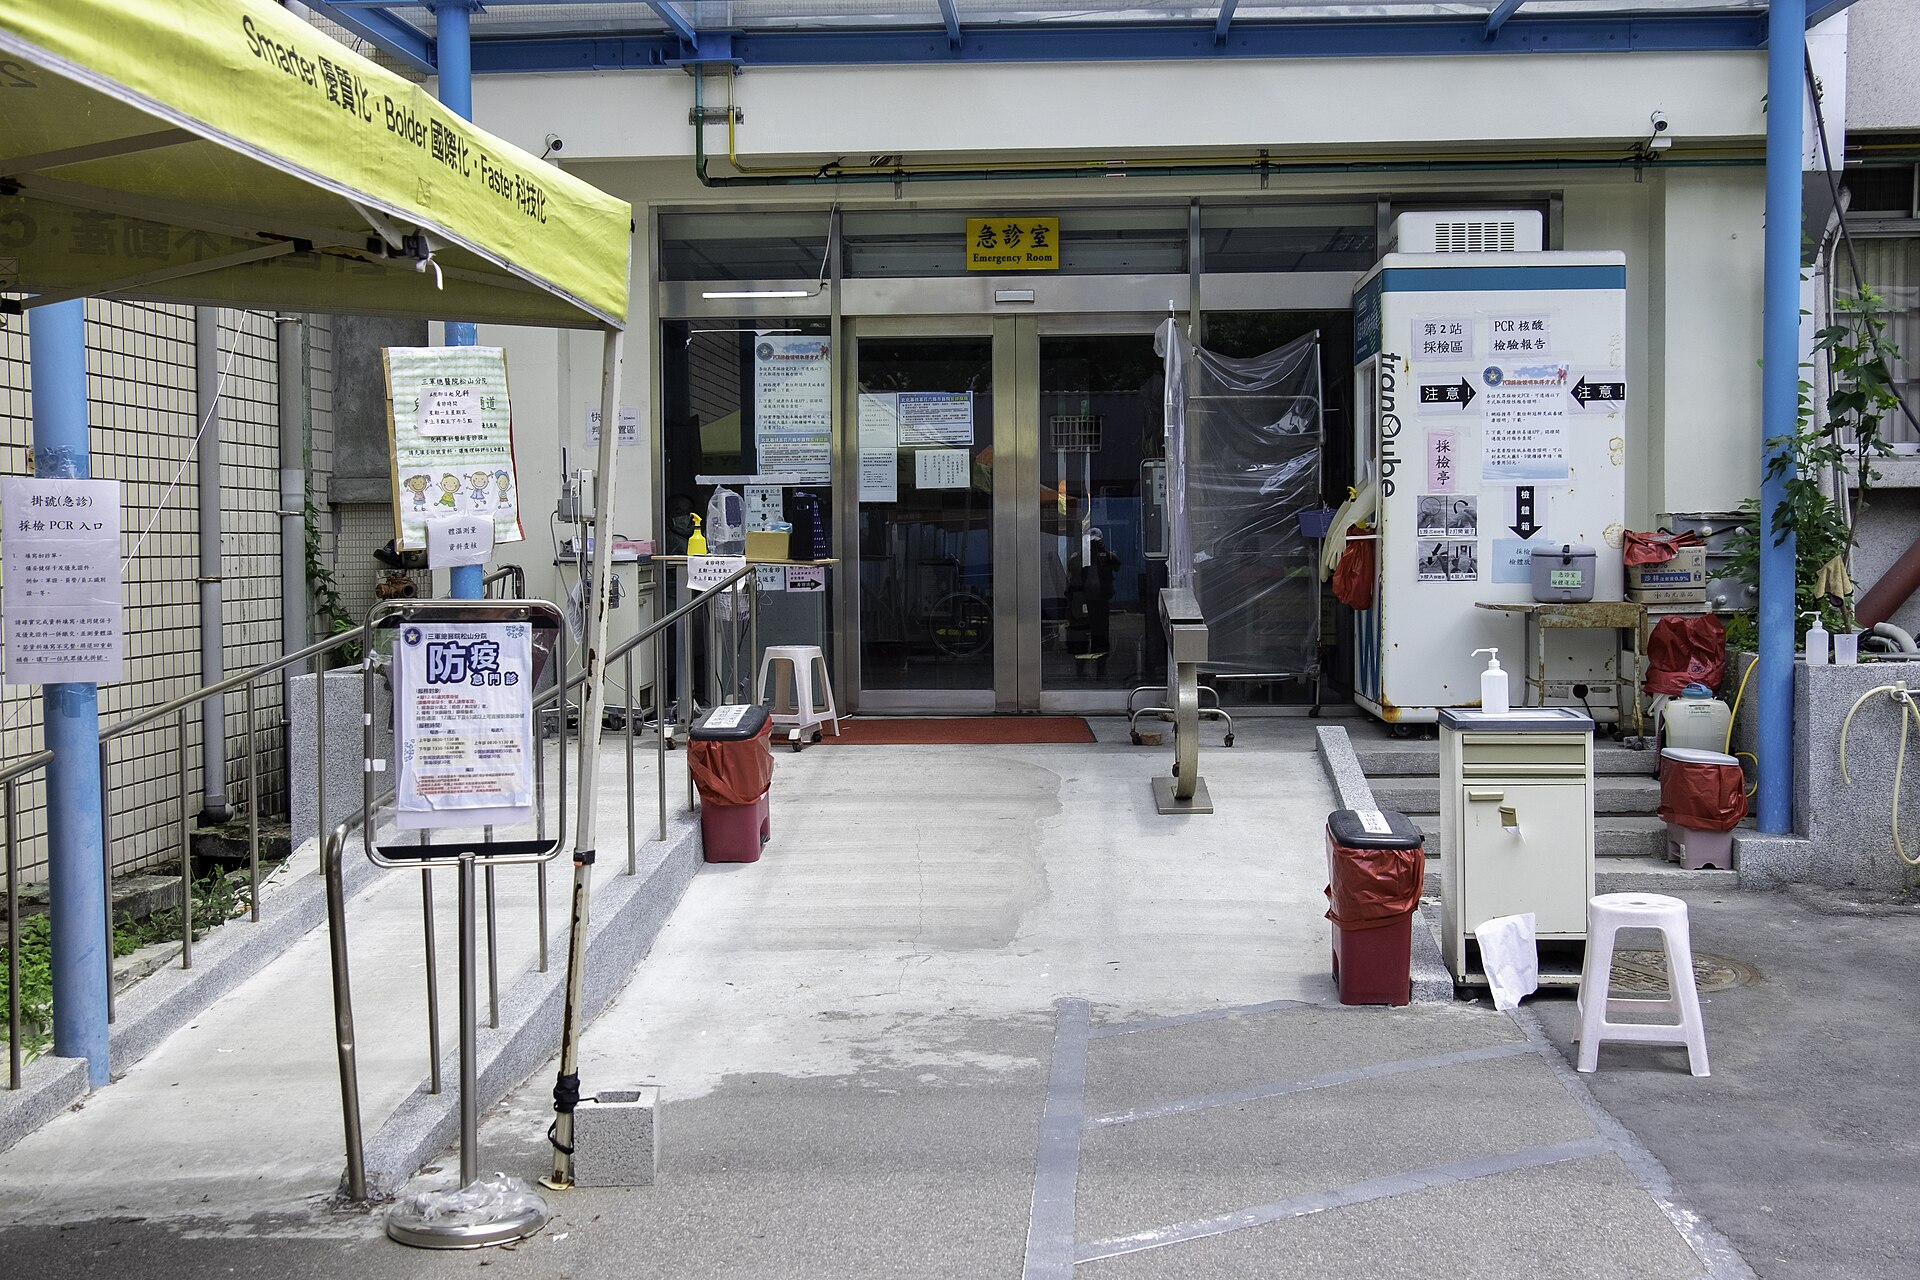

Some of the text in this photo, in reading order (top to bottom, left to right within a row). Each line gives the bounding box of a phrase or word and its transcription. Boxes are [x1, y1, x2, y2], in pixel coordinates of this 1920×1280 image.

[242, 14, 546, 224] Smarter 優質化 Bolder 國際化 Faster 科技化
[977, 223, 1050, 249] 急診室
[973, 252, 1053, 264] Emergency Room
[1494, 319, 1544, 331] PCR 核酸
[1423, 340, 1463, 354] 採檢區
[1493, 338, 1546, 351] 檢驗報告
[1435, 439, 1451, 485] 採檢亭
[1520, 490, 1530, 531] 檢體箱
[18, 520, 103, 531] 採檢 PCR 入口
[427, 640, 500, 685] 防疫
[470, 671, 519, 686] 急門診
